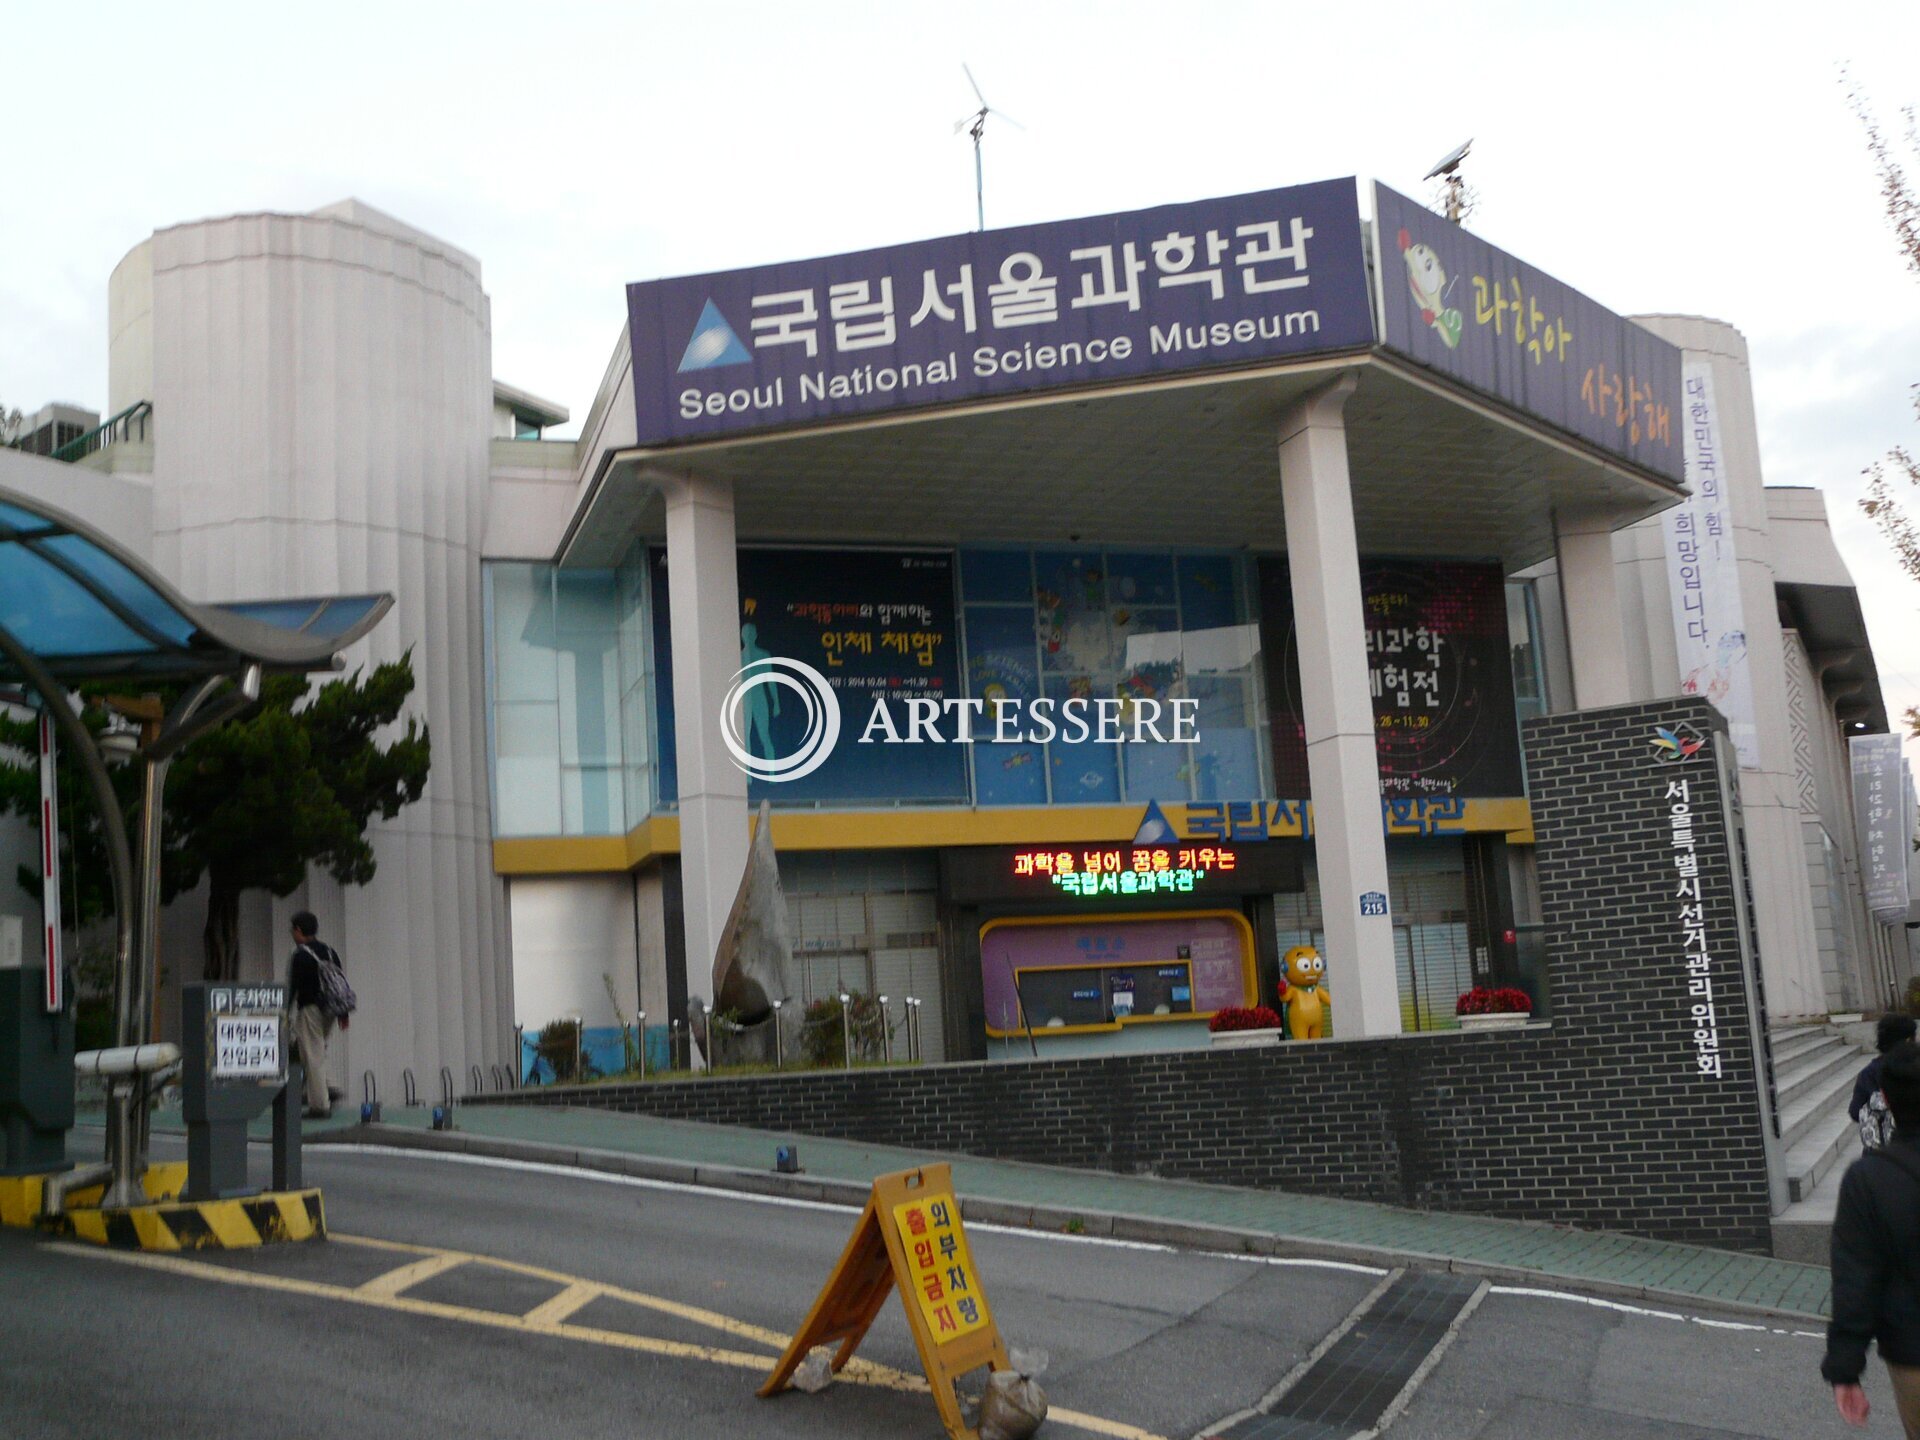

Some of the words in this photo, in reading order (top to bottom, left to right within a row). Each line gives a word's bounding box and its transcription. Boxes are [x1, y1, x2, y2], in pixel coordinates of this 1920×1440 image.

[750, 217, 1313, 358] 국립서울과학관
[1472, 275, 1572, 365] 과학아
[679, 376, 783, 419] Seoul
[799, 351, 957, 404] National
[972, 331, 1132, 377] Science
[1150, 305, 1320, 355] Museum
[1581, 363, 1670, 448] 사랑해
[1686, 376, 1718, 503] 대한민국의
[1675, 512, 1709, 649] 희망입니다.
[821, 631, 872, 667] 인체
[1014, 852, 1074, 875] 과학을
[1083, 851, 1121, 874] 넘어
[1132, 849, 1170, 873] 꿈을
[1178, 848, 1236, 870] 키우는
[1186, 796, 1466, 841] 국립서학관
[1052, 869, 1205, 896] "국립서울과학관"
[1364, 902, 1383, 915] 215
[1665, 779, 1722, 1079] 서울특별시선거관리위원회
[221, 1022, 276, 1043] 대형버스
[222, 1047, 275, 1067] 진입금지
[905, 1207, 958, 1333] 출입금지
[930, 1200, 979, 1325] 외부차량
